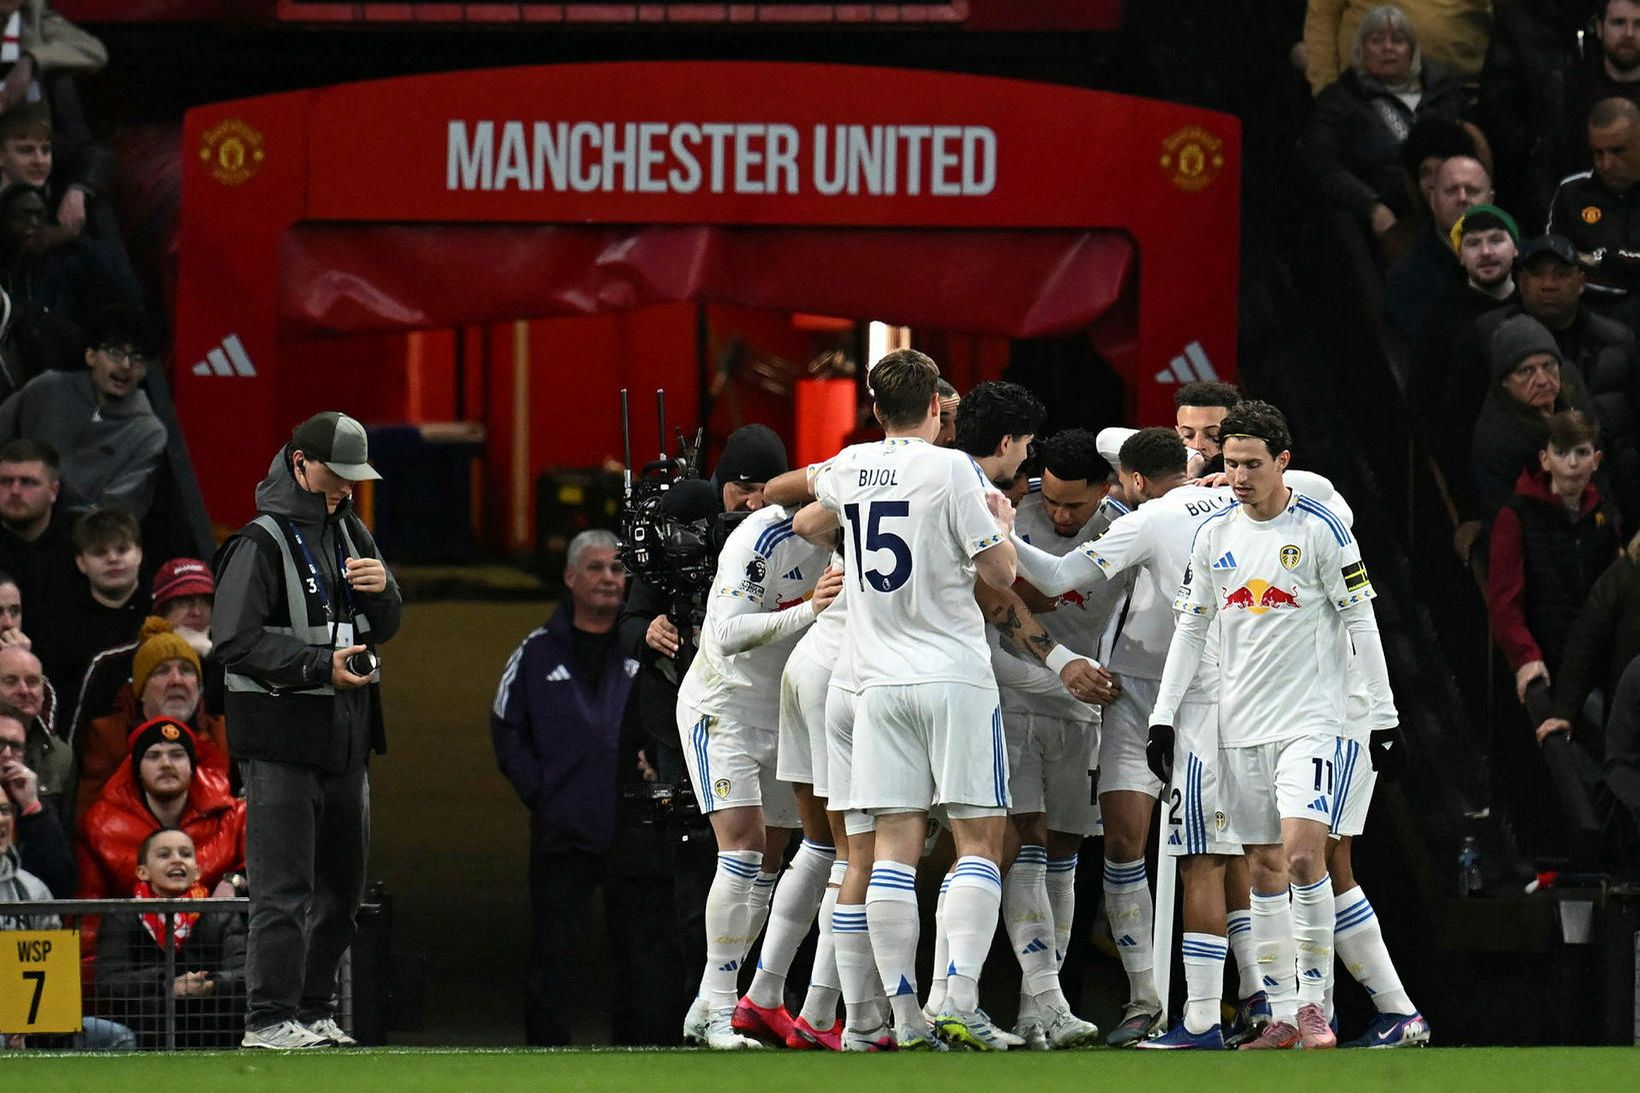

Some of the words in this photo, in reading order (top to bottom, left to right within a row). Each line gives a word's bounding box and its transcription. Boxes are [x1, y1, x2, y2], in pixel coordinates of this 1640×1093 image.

[447, 119, 799, 195] MANCHESTER
[813, 123, 998, 197] UNITED
[858, 468, 899, 488] BIJOL
[844, 500, 913, 593] 15
[306, 577, 320, 594] 3
[1312, 757, 1333, 796] 11
[1168, 788, 1183, 825] 2
[17, 939, 52, 963] WSP
[22, 970, 46, 1025] 7
